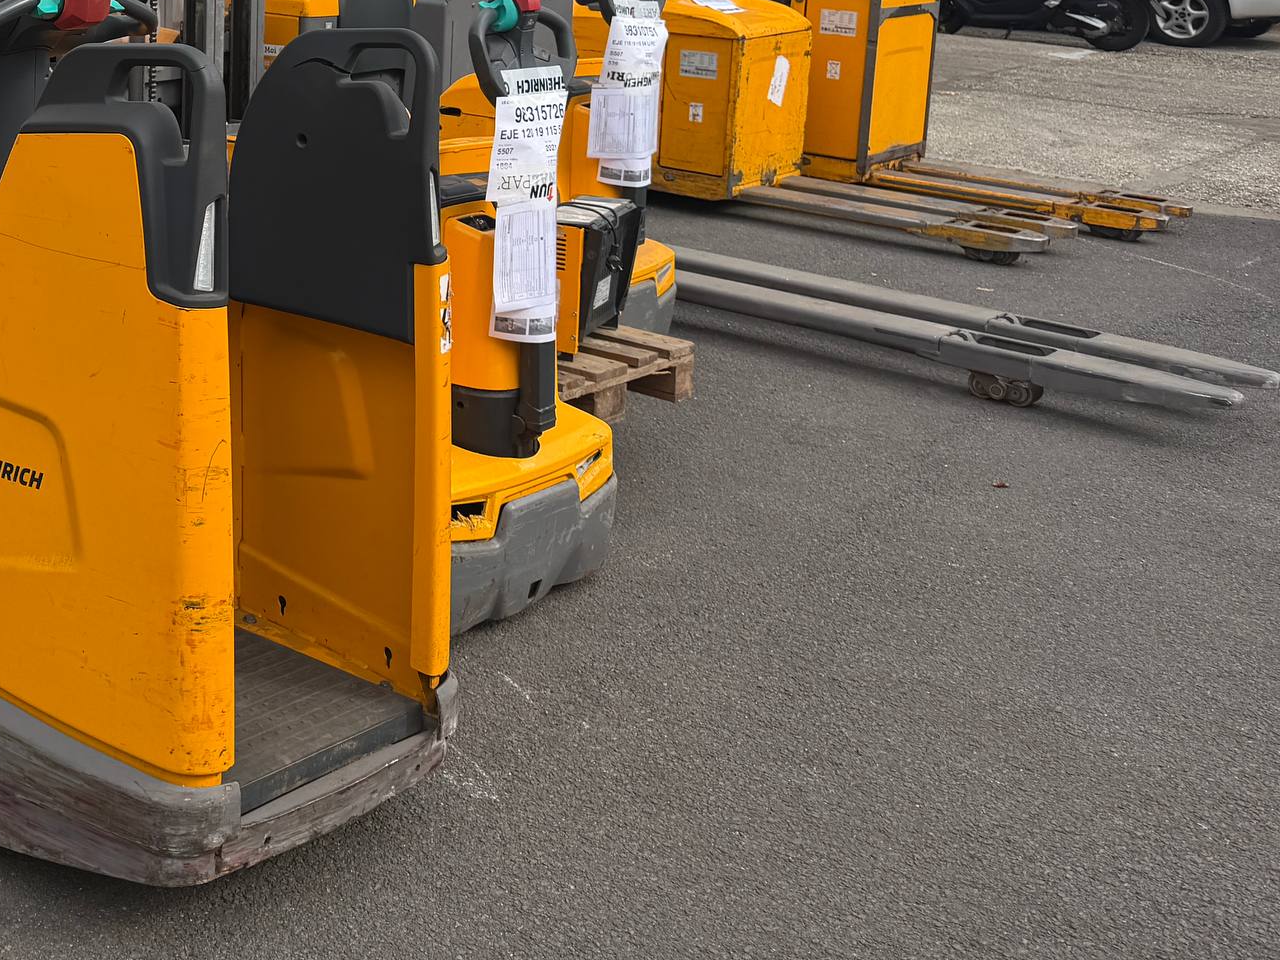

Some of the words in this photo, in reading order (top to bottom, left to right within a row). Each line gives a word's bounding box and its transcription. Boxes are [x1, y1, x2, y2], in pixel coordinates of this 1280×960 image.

[500, 129, 519, 140] EJE
[535, 126, 544, 137] 19
[545, 125, 558, 136] 115
[497, 147, 514, 155] 5507
